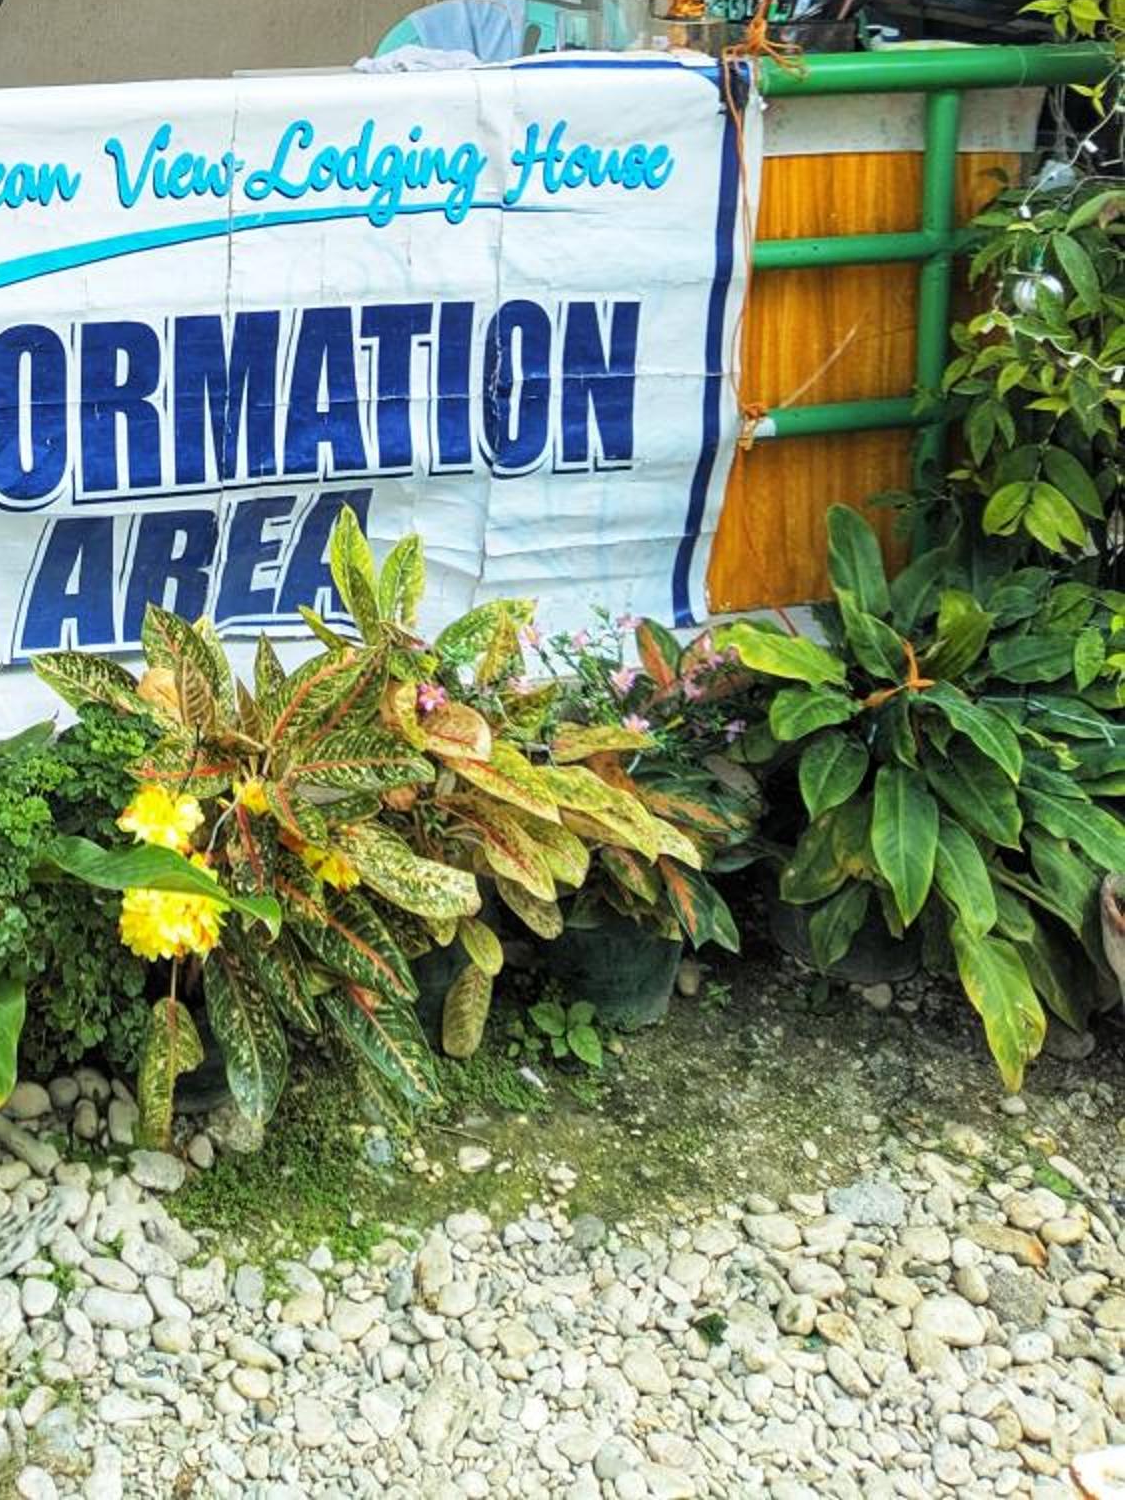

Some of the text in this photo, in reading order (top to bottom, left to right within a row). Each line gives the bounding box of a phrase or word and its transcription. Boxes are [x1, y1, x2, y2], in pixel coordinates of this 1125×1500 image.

[104, 123, 243, 210] View
[243, 119, 489, 228] Lodging
[503, 119, 675, 206] House
[12, 488, 372, 663] AREA
